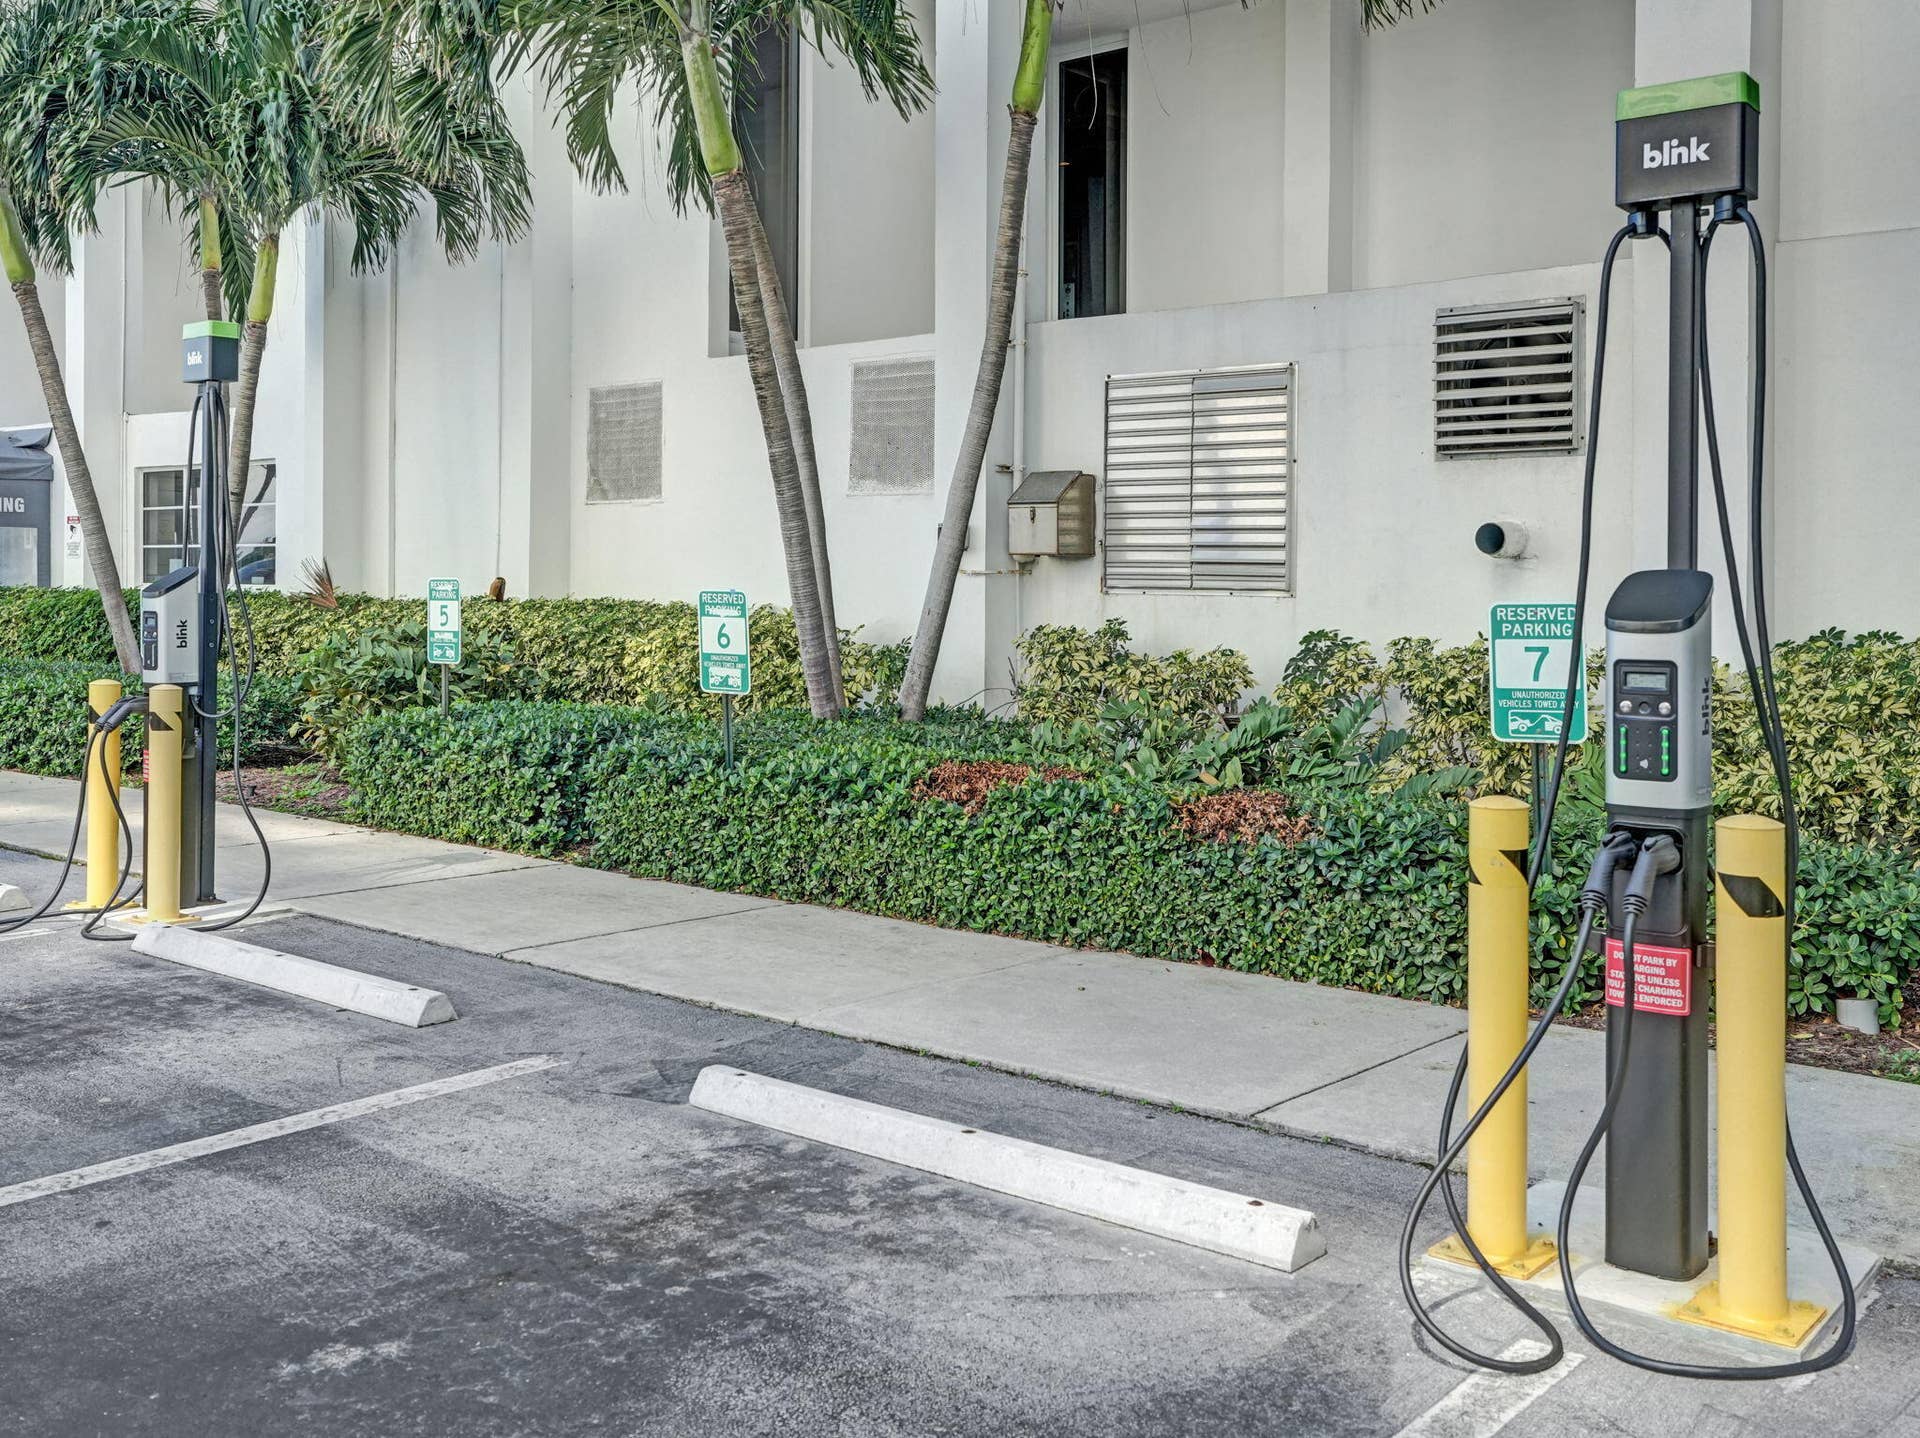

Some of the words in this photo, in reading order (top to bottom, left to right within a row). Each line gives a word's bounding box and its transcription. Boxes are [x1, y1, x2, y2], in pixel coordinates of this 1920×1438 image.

[1643, 136, 1711, 169] blink
[702, 593, 744, 604] RESERVED
[440, 605, 448, 626] 5
[1496, 607, 1576, 620] RESERVED
[176, 619, 188, 649] blink
[718, 623, 730, 648] 6
[1502, 623, 1573, 637] PARKING
[1524, 647, 1549, 681] 7
[1511, 690, 1566, 700] UNAUTHORIZED
[1498, 699, 1532, 709] VEHICLES
[1535, 700, 1558, 709] TOWED
[1560, 700, 1580, 709] AY
[1701, 677, 1710, 736] blink
[1642, 955, 1664, 966] PARK
[1666, 958, 1678, 968] BY
[1630, 964, 1666, 976] ARGING
[1647, 975, 1680, 987] UNLESS
[1639, 994, 1683, 1007] ENFORCED
